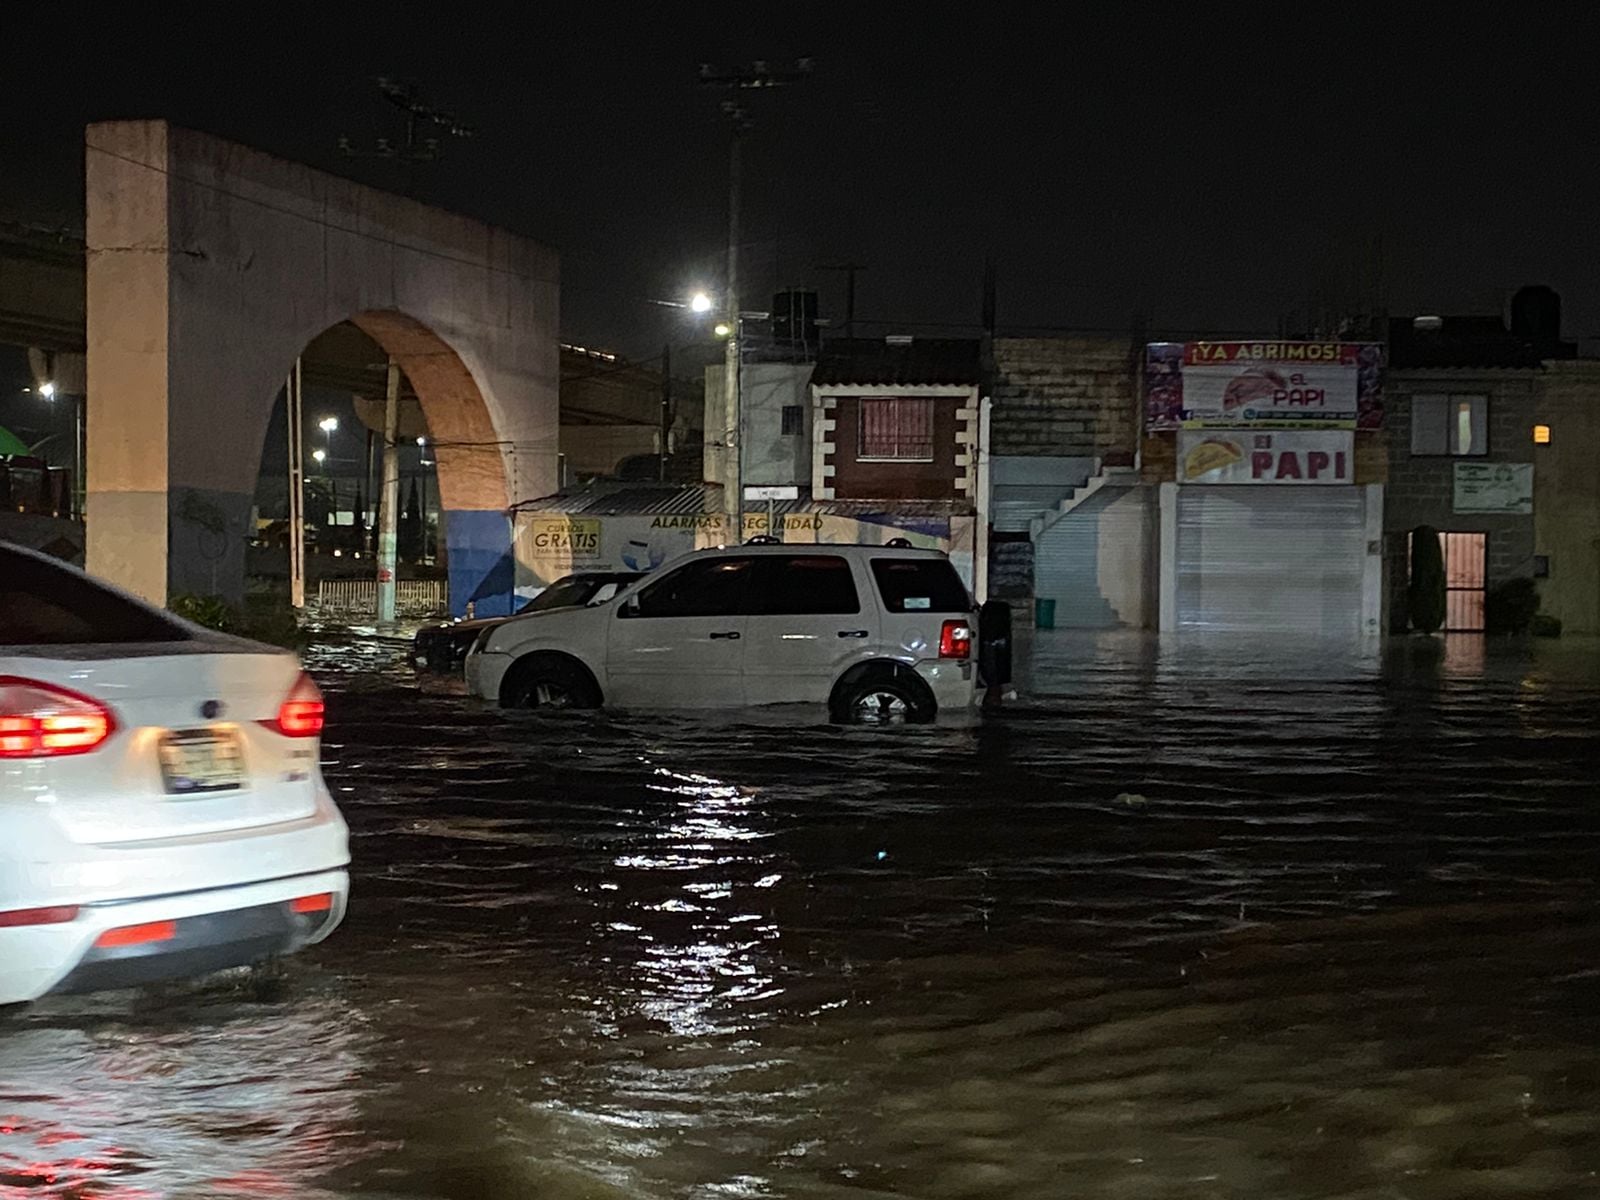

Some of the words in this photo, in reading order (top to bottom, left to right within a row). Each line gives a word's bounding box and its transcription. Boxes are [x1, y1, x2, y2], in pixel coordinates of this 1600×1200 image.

[1192, 344, 1227, 364] ¡YA
[1235, 344, 1342, 360] ABRIMOS!
[1290, 373, 1307, 385] EL
[1273, 389, 1325, 406] PAPI
[1251, 451, 1346, 479] PAPI
[651, 516, 722, 529] ALARMAS
[534, 533, 598, 548] GRATIS
